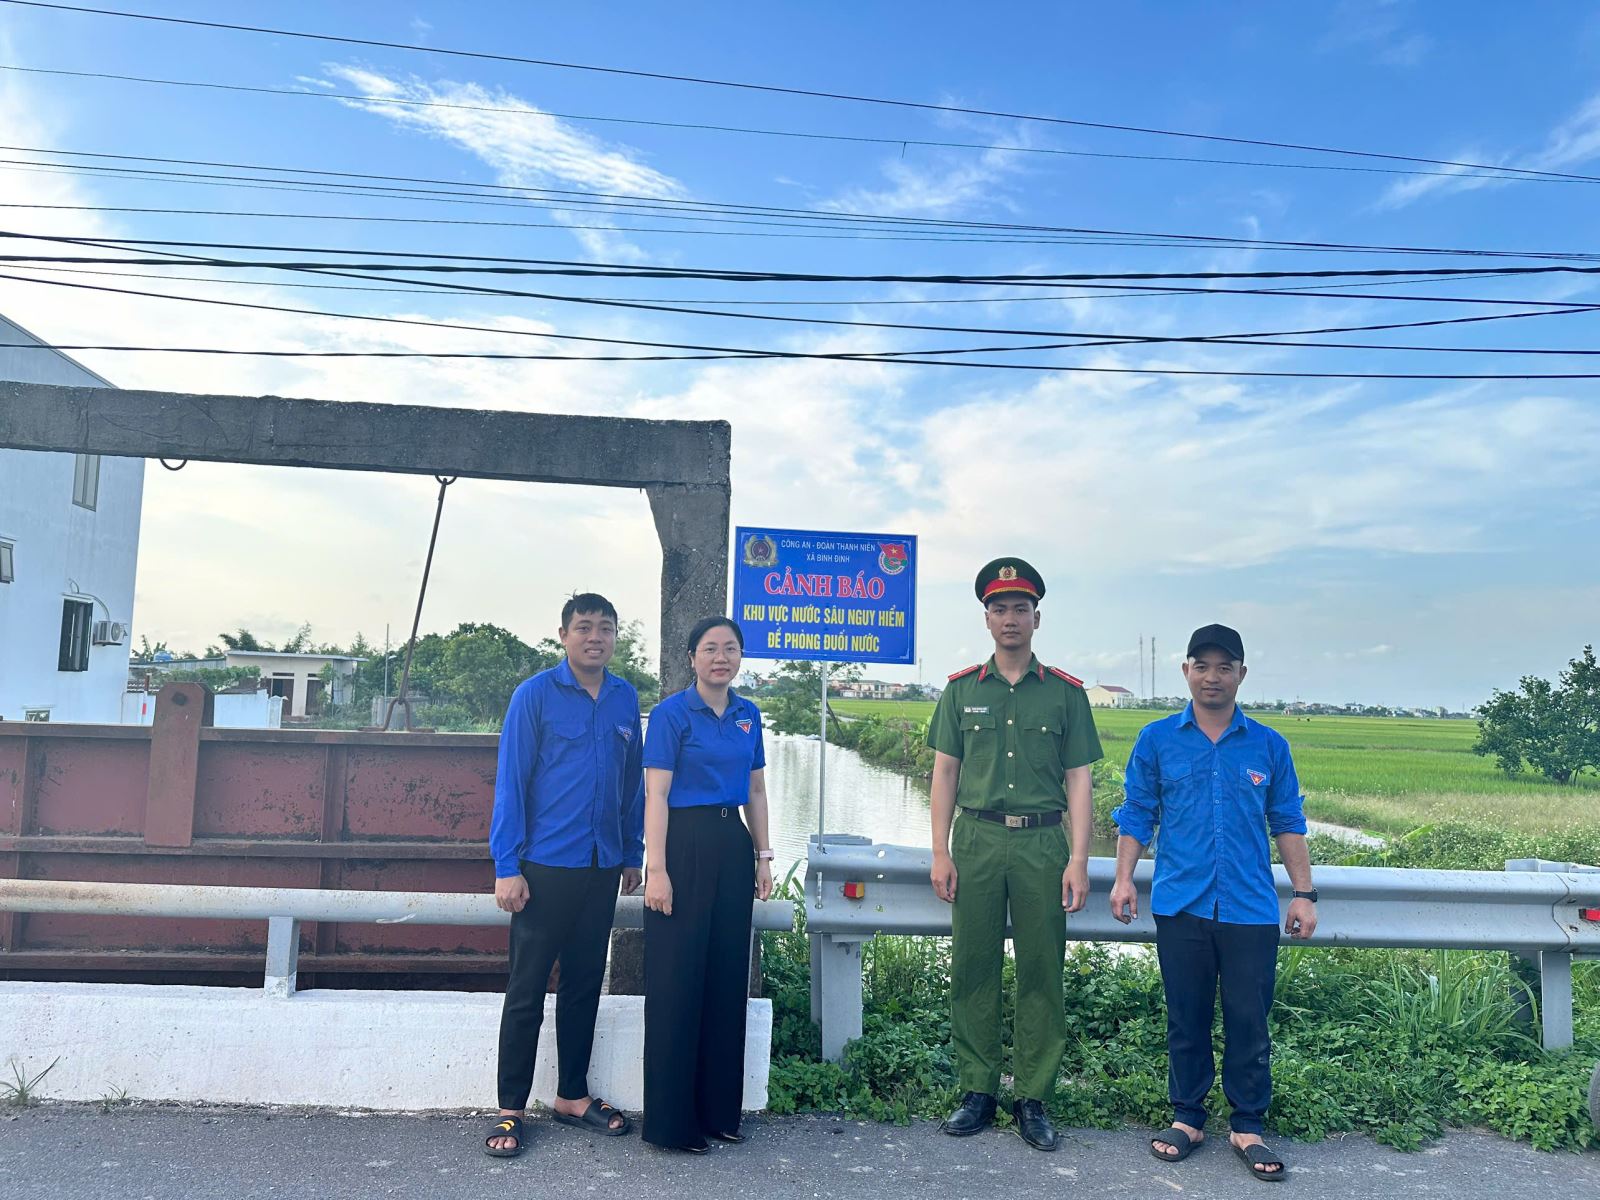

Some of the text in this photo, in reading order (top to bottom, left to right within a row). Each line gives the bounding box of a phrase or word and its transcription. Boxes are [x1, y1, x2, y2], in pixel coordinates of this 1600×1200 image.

[781, 539, 800, 548] CÔNG
[801, 541, 811, 549] AN
[836, 542, 859, 551] THANH
[859, 541, 876, 552] NIÊN
[763, 565, 885, 599] CẢNH BÁO
[743, 603, 905, 628] KHU VỰC NƯỚC SÂU NGUY HIỂM
[784, 628, 821, 650] PHÒNG
[823, 628, 848, 651] ĐUỐI
[851, 632, 880, 653] NƯỚC
